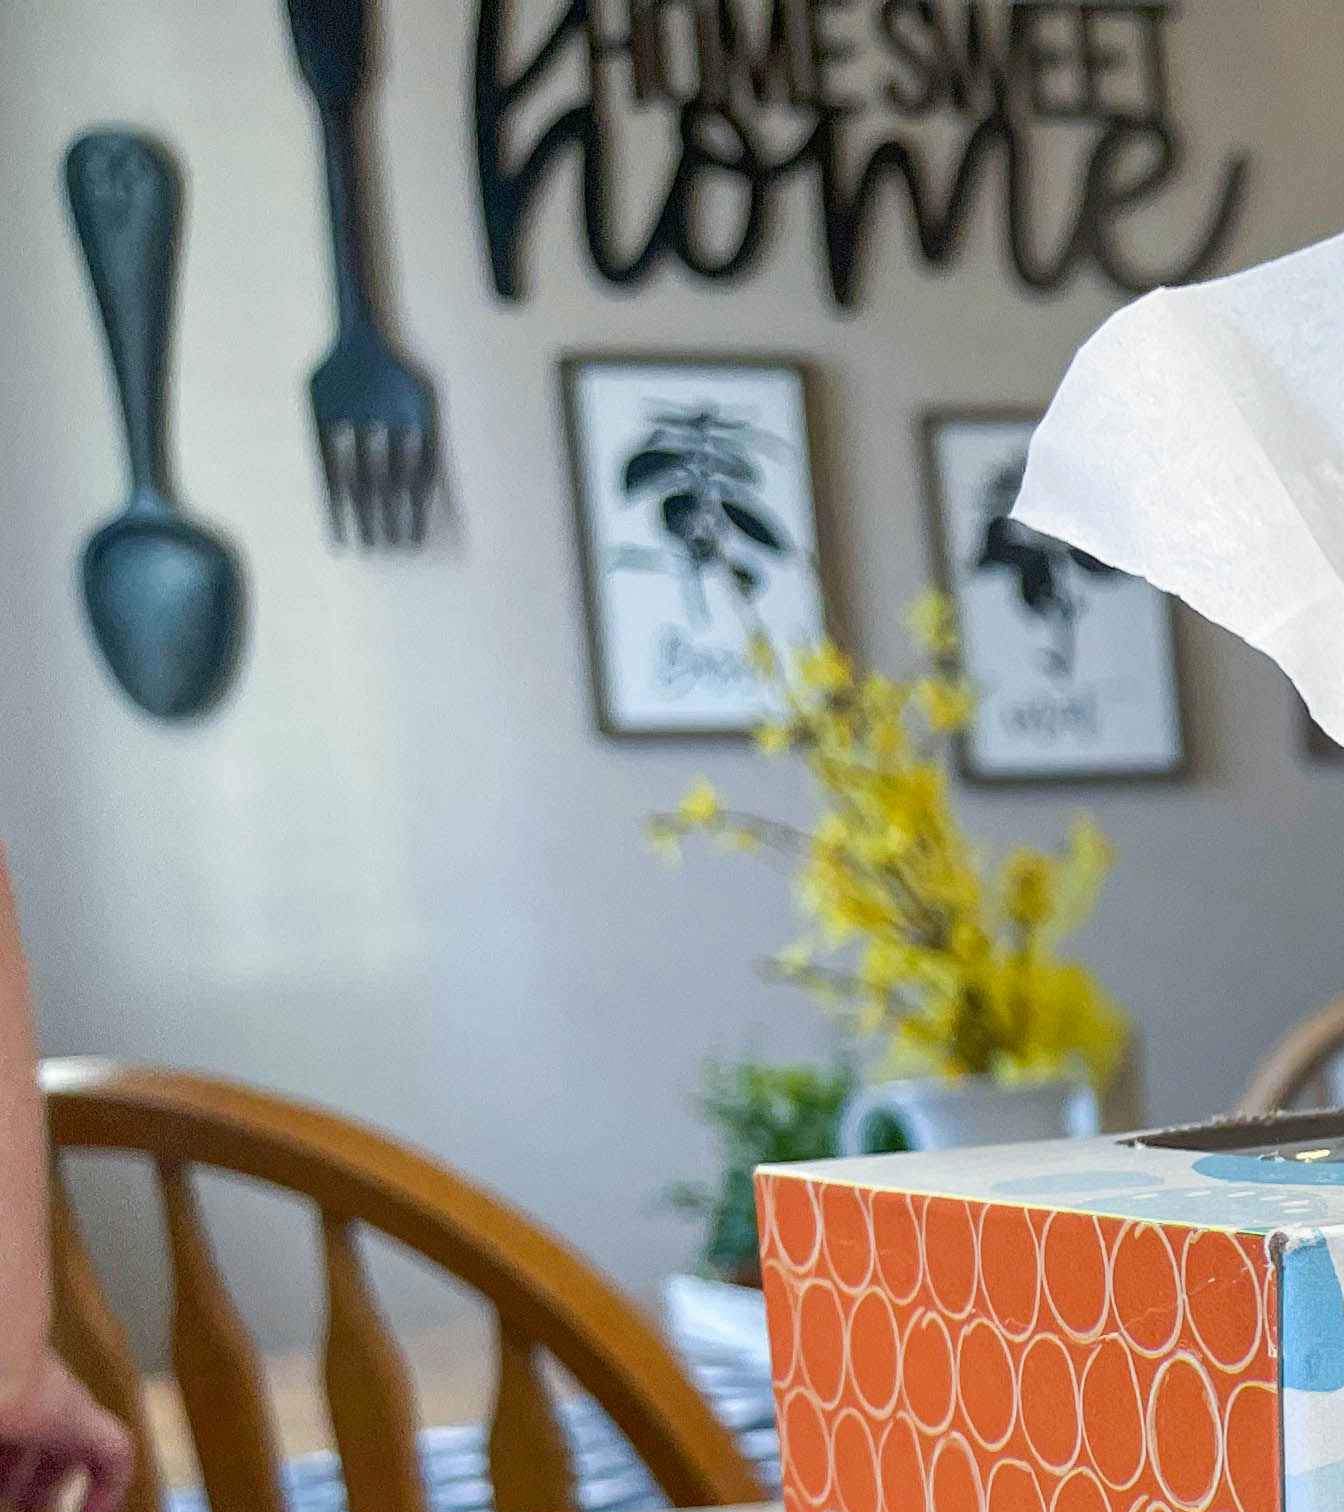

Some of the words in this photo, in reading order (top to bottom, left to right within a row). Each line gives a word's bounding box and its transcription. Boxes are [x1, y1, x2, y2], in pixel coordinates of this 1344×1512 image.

[474, 0, 1250, 304] home
[592, 0, 852, 112] HOME
[876, 0, 1180, 124] SWEET
